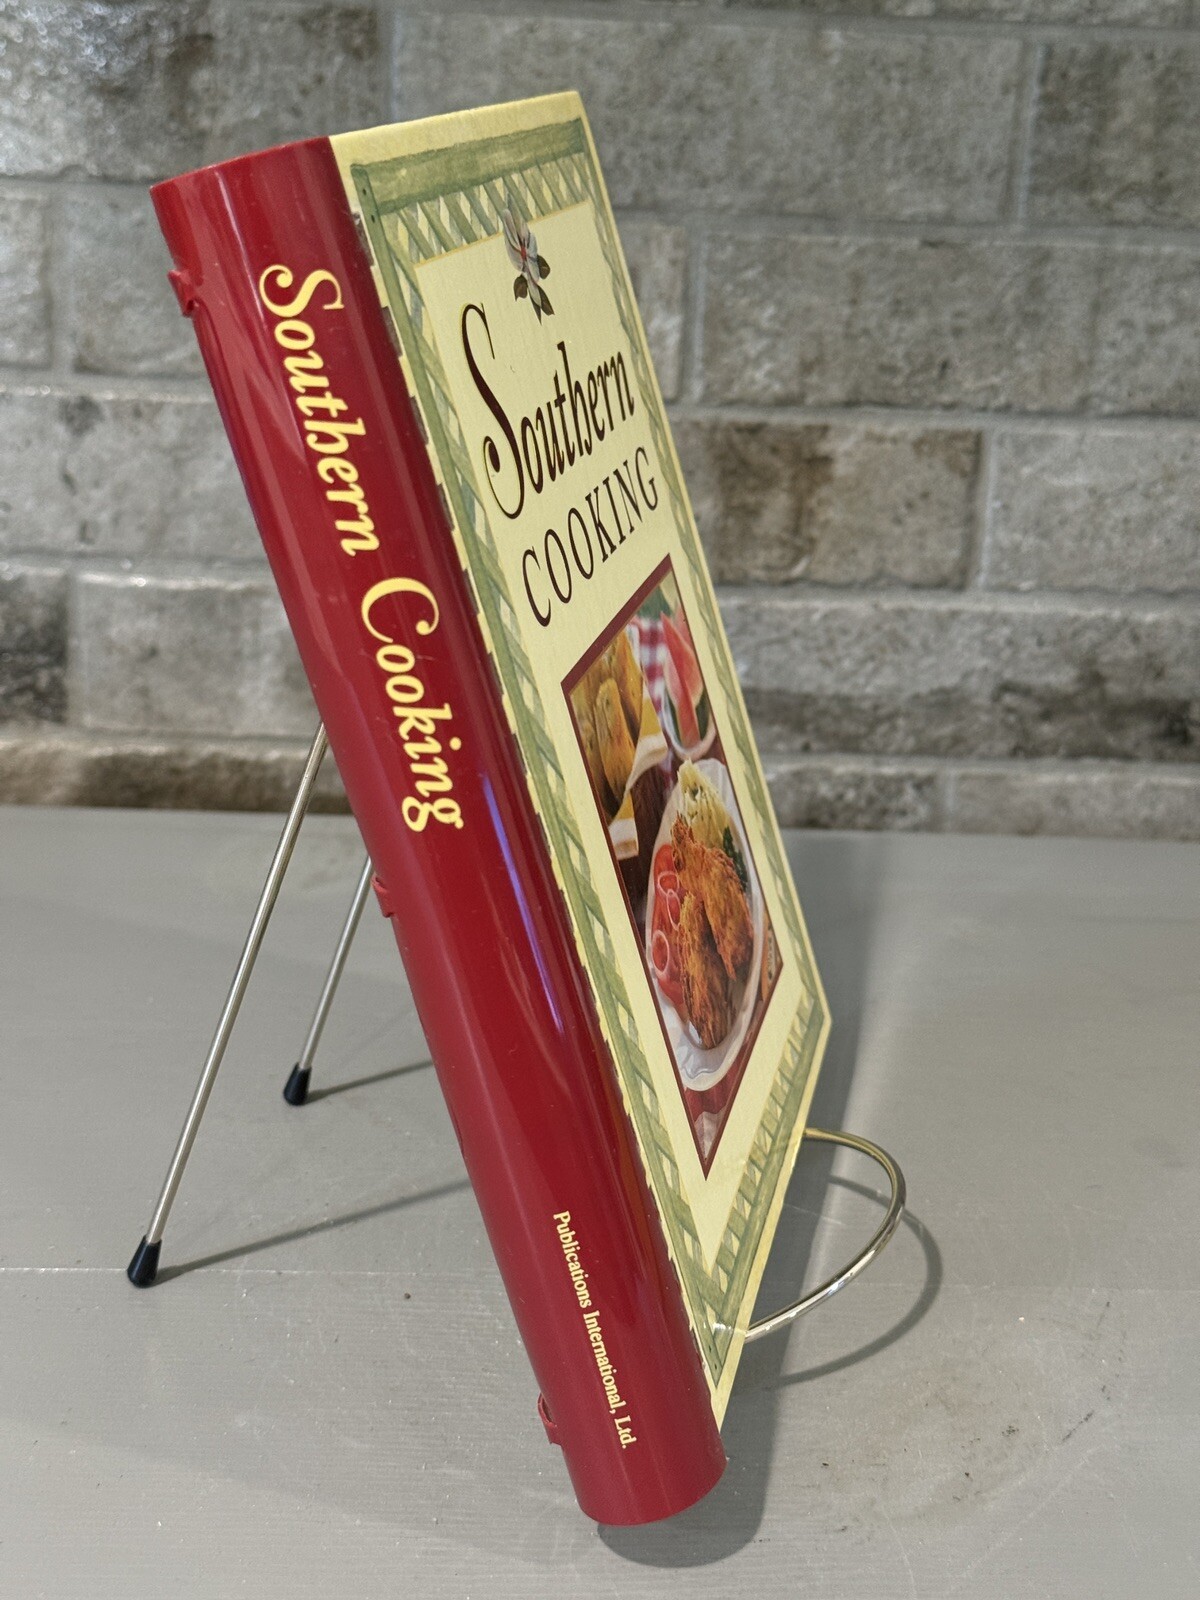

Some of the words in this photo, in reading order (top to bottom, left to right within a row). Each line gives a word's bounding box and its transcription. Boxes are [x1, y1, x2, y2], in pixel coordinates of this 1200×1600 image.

[462, 302, 634, 519] Southern
[259, 264, 380, 557] Southern
[361, 577, 464, 832] Cooking
[522, 446, 658, 627] COOKING
[553, 1210, 592, 1309] Publications
[583, 1310, 627, 1414] International,
[614, 1415, 637, 1449] Ltd.
